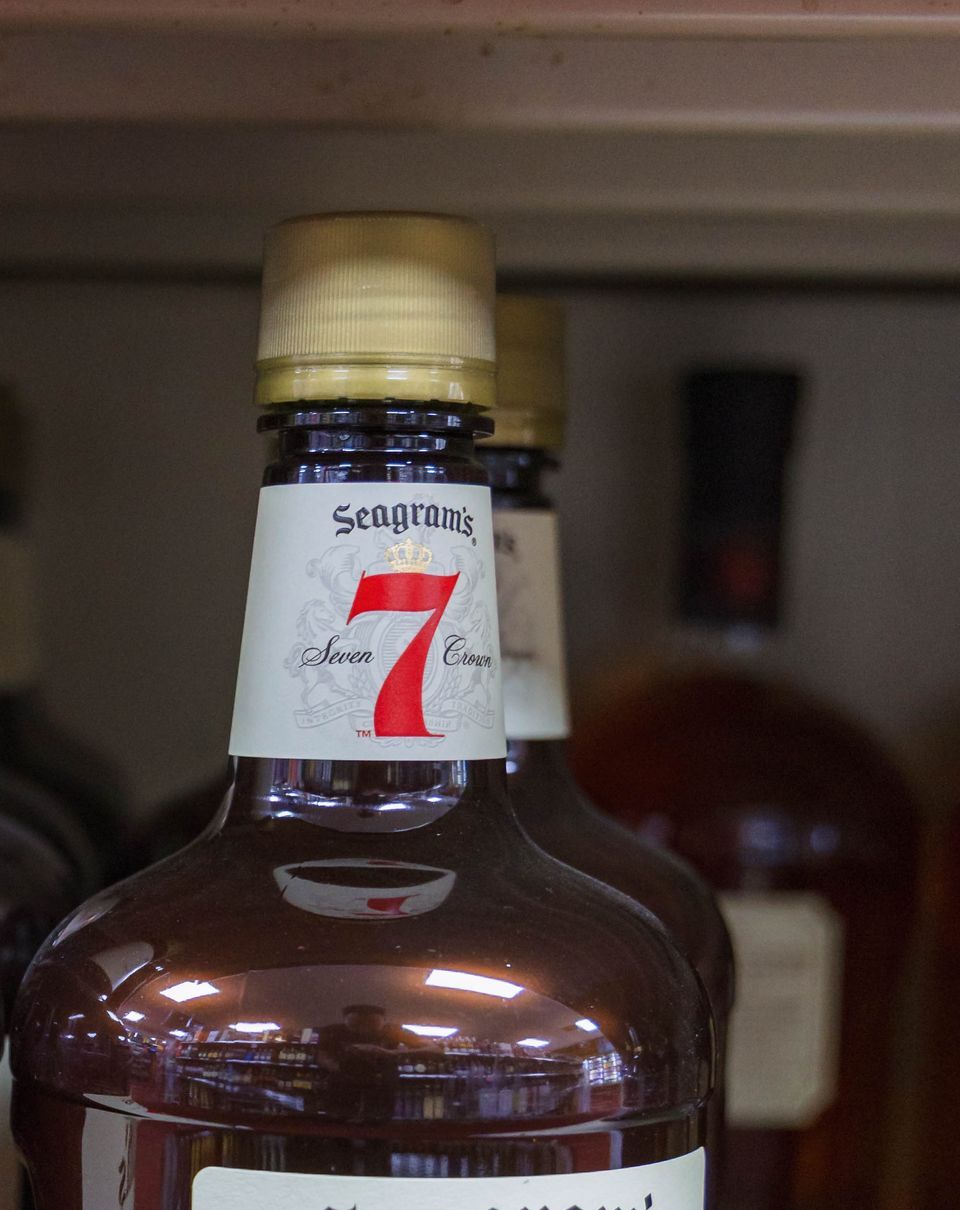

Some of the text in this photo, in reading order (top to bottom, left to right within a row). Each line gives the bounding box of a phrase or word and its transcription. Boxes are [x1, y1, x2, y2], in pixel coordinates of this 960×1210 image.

[332, 502, 474, 537] Seagram's
[298, 634, 492, 668] Seven Crown
[346, 570, 461, 737] 7
